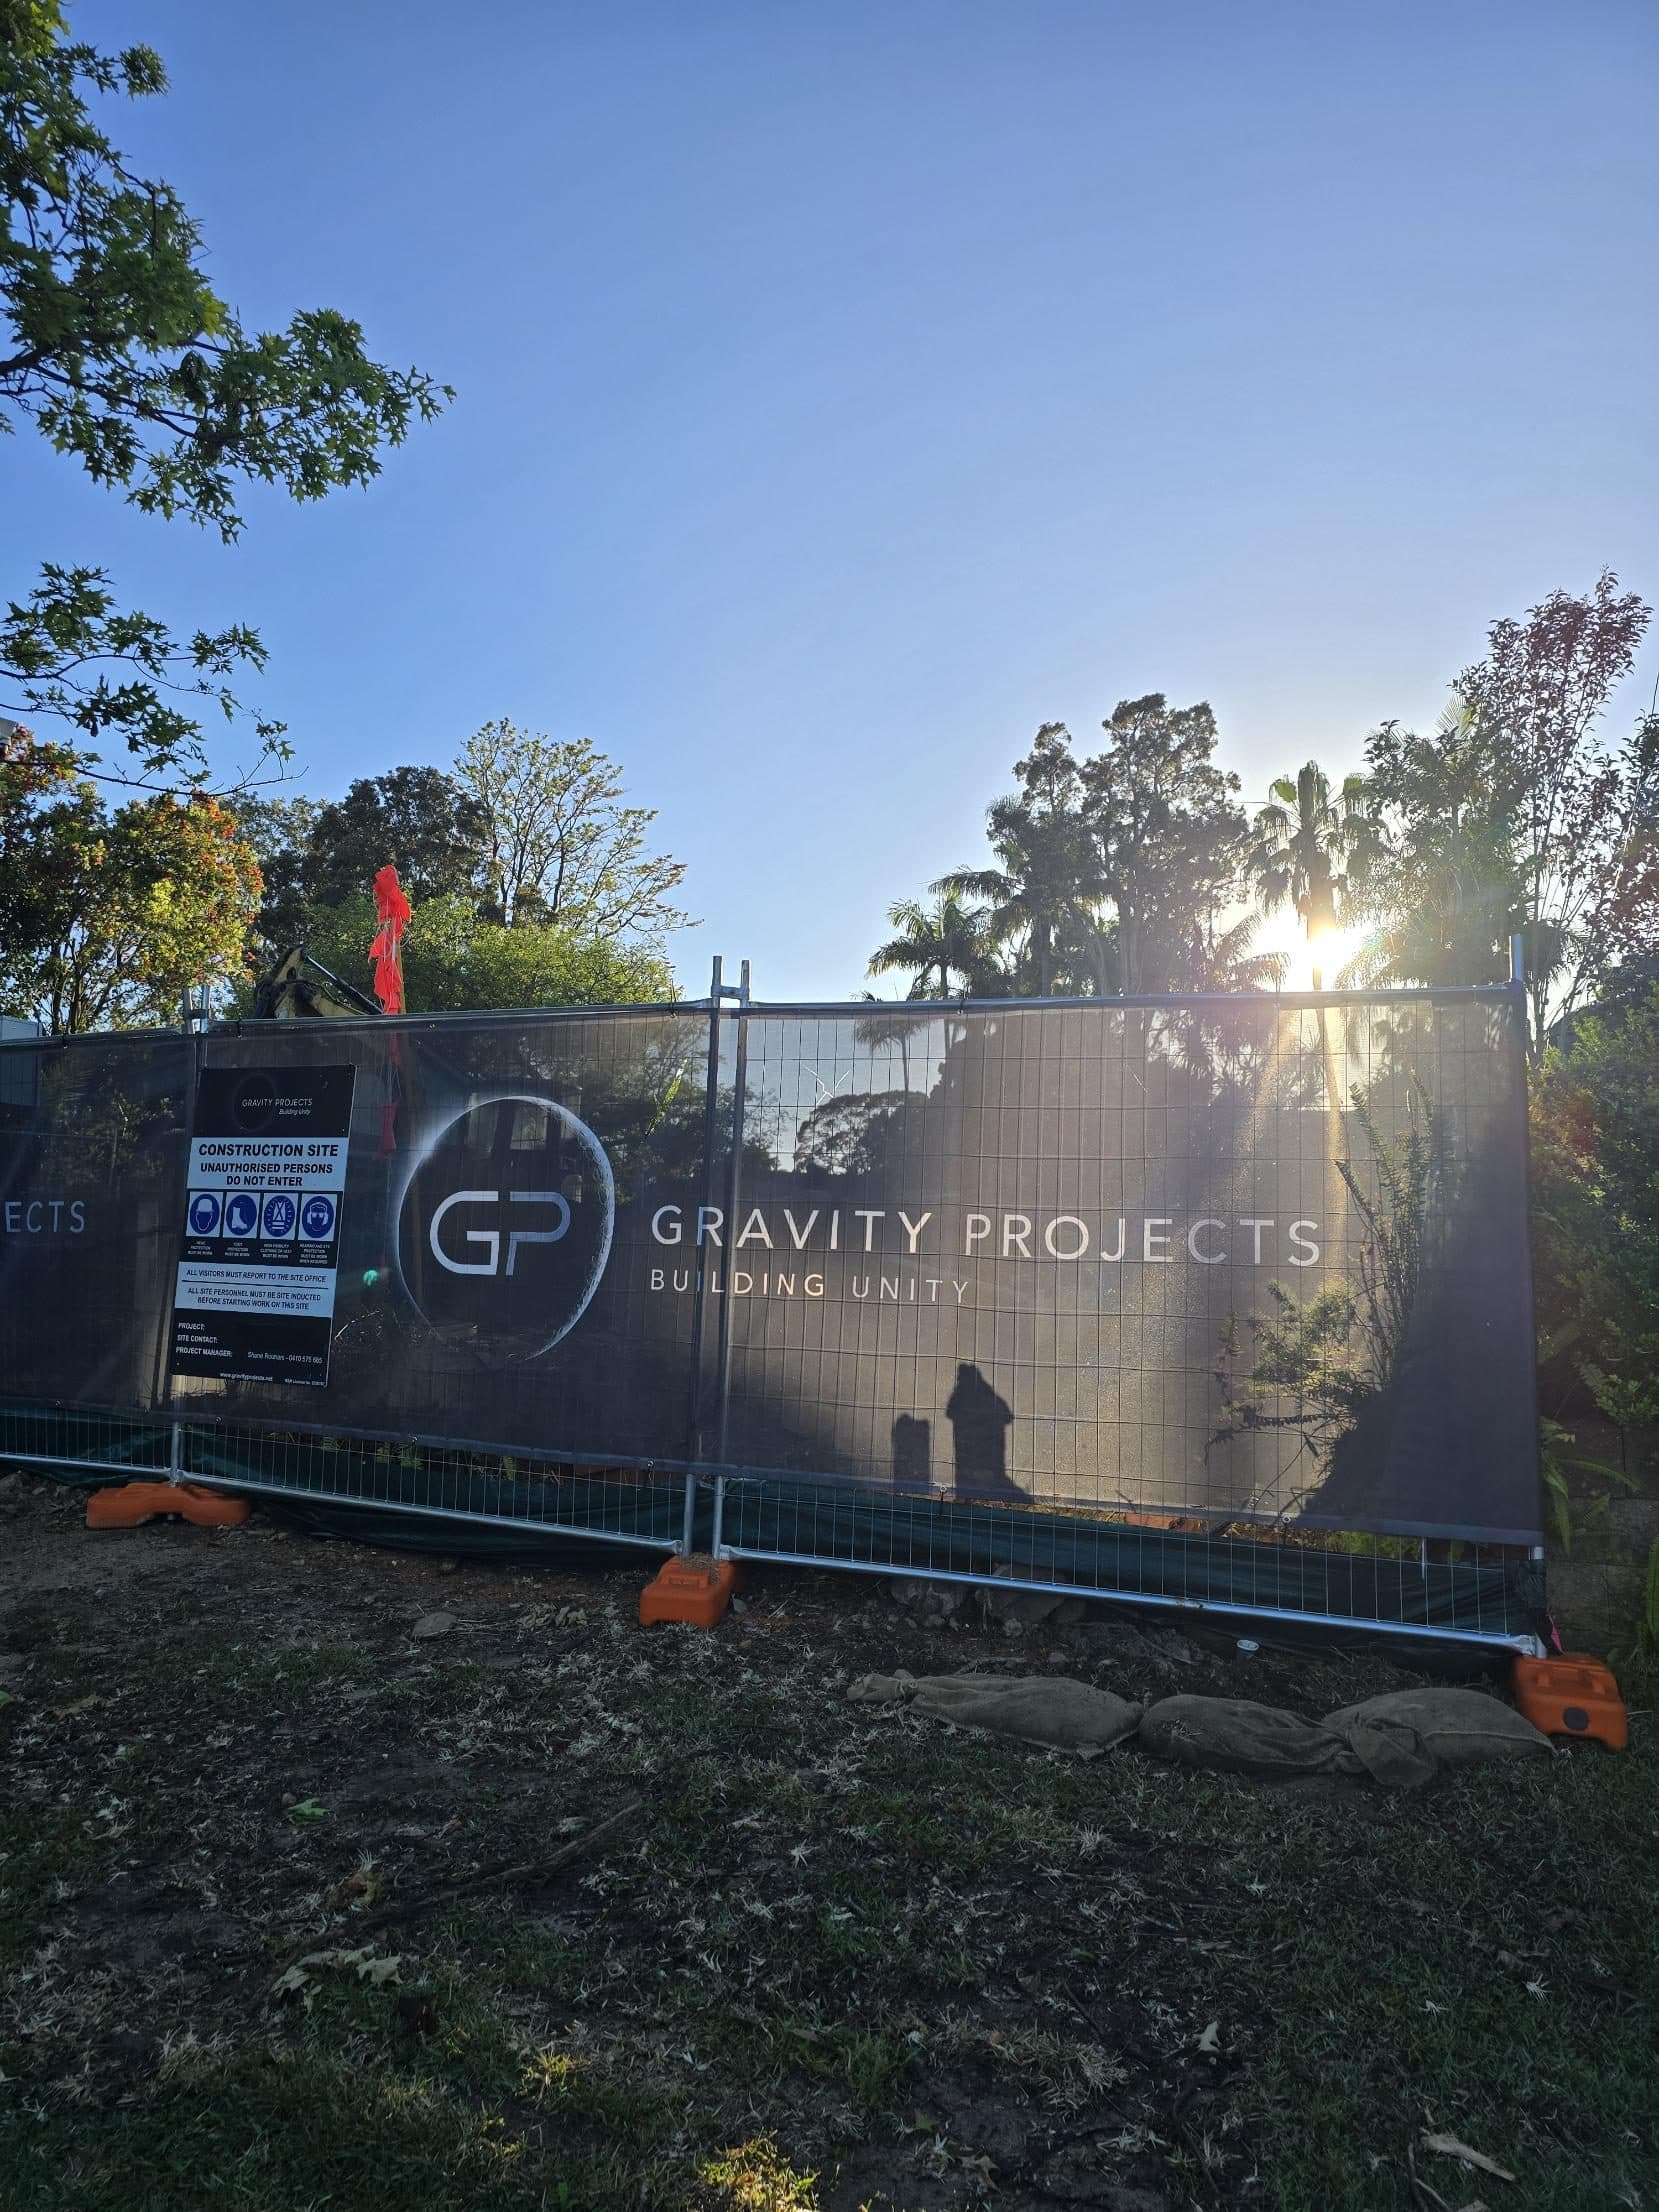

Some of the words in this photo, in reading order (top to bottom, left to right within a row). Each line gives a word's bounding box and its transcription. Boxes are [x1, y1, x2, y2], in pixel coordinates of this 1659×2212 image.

[241, 1098, 273, 1107] GRAVITY
[274, 1098, 313, 1107] PROJECTS
[199, 1143, 303, 1156] CONSTRUCTION
[307, 1144, 339, 1157] SITE
[200, 1162, 281, 1173] UNAUTHORISED
[283, 1163, 333, 1174] PERSONS
[226, 1175, 241, 1186] DO
[243, 1175, 265, 1186] NOT
[267, 1176, 303, 1187] ENTER
[430, 1190, 571, 1276] GP
[651, 1204, 933, 1254] GRAVITY
[965, 1213, 1320, 1267] PROJECTS
[198, 1270, 225, 1278] VISITORS
[242, 1271, 267, 1280] REPORT
[276, 1273, 289, 1281] THE
[650, 1268, 825, 1297] BUILDING
[851, 1275, 969, 1303] UNITY
[188, 1287, 199, 1295] ALL
[213, 1288, 248, 1297] PERSONNEL
[250, 1290, 266, 1298] MUST
[277, 1291, 289, 1299] SITE
[290, 1292, 321, 1301] INDUCTED
[197, 1296, 222, 1304] BEFORE
[222, 1297, 251, 1306] STARTING
[251, 1299, 270, 1307] WORK
[271, 1300, 280, 1308] ON
[281, 1301, 294, 1309] THIS
[295, 1302, 309, 1310] SITE
[178, 1322, 205, 1331] PROJECT:
[177, 1334, 189, 1342] SITE
[190, 1335, 218, 1344] CONTACT:
[175, 1346, 202, 1355] PROJECT
